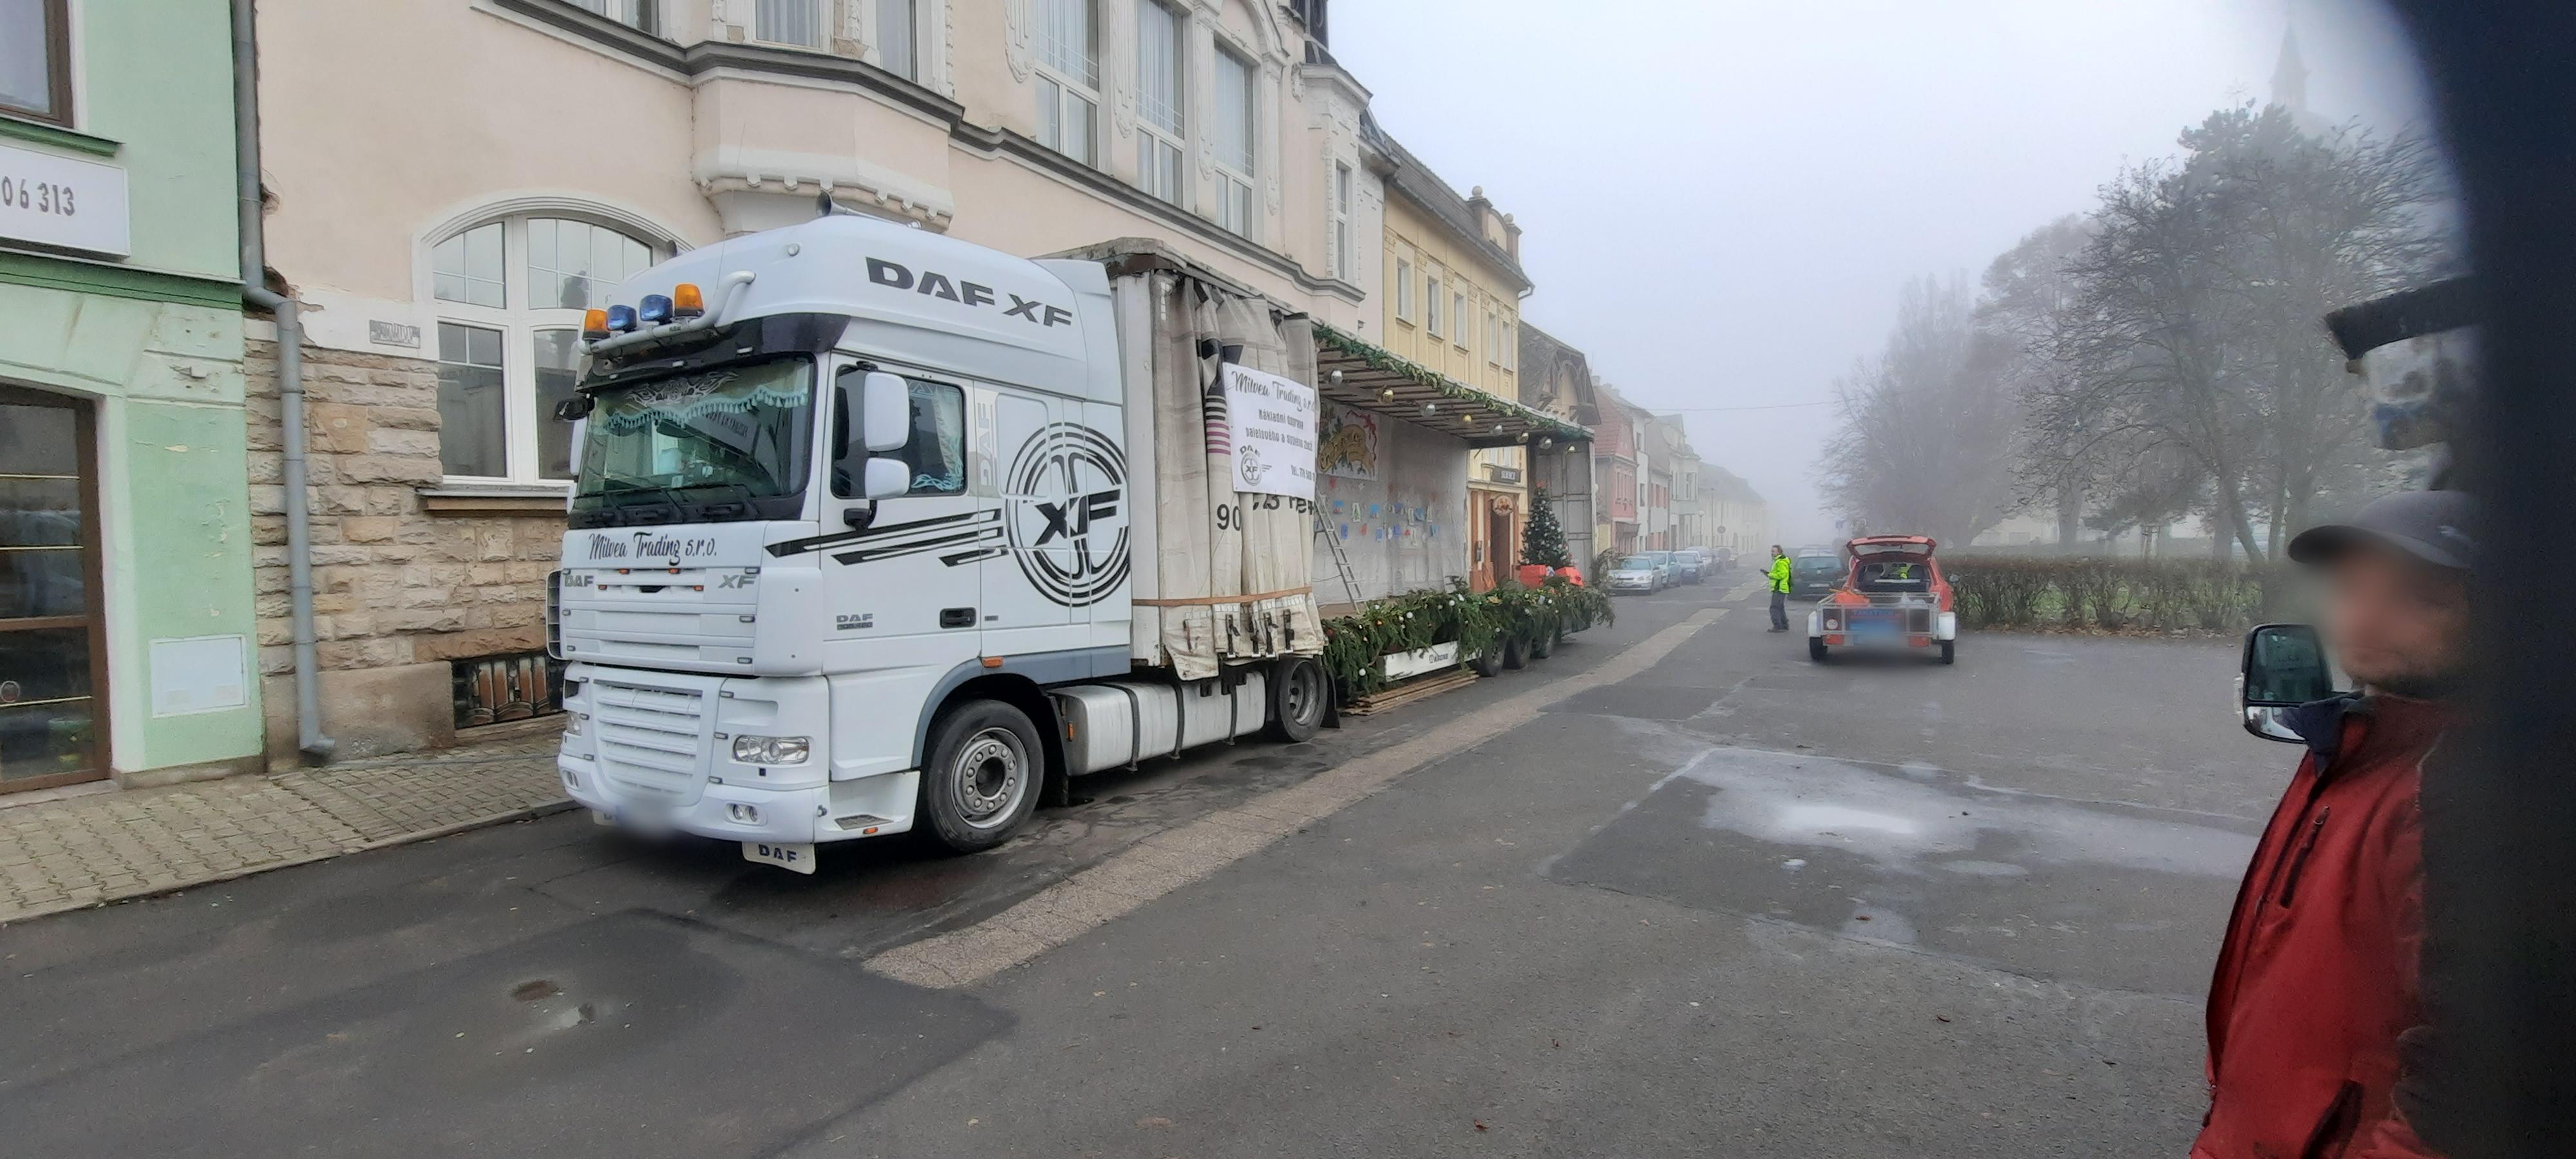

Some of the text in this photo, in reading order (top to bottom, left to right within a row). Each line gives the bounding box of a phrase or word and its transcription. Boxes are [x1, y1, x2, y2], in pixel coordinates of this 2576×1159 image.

[2, 176, 75, 216] 06 313
[866, 256, 1072, 327] DAF XF
[1231, 371, 1270, 397] Milvea
[1273, 381, 1302, 412] Trading
[1282, 433, 1285, 443] a
[1245, 465, 1258, 473] XF
[1033, 489, 1121, 547] XF
[589, 531, 717, 566] Milvea Trading s.r.o.
[564, 575, 594, 587] DAF
[718, 574, 757, 589] XF
[837, 614, 873, 623] DAF
[758, 843, 797, 862] DAF
